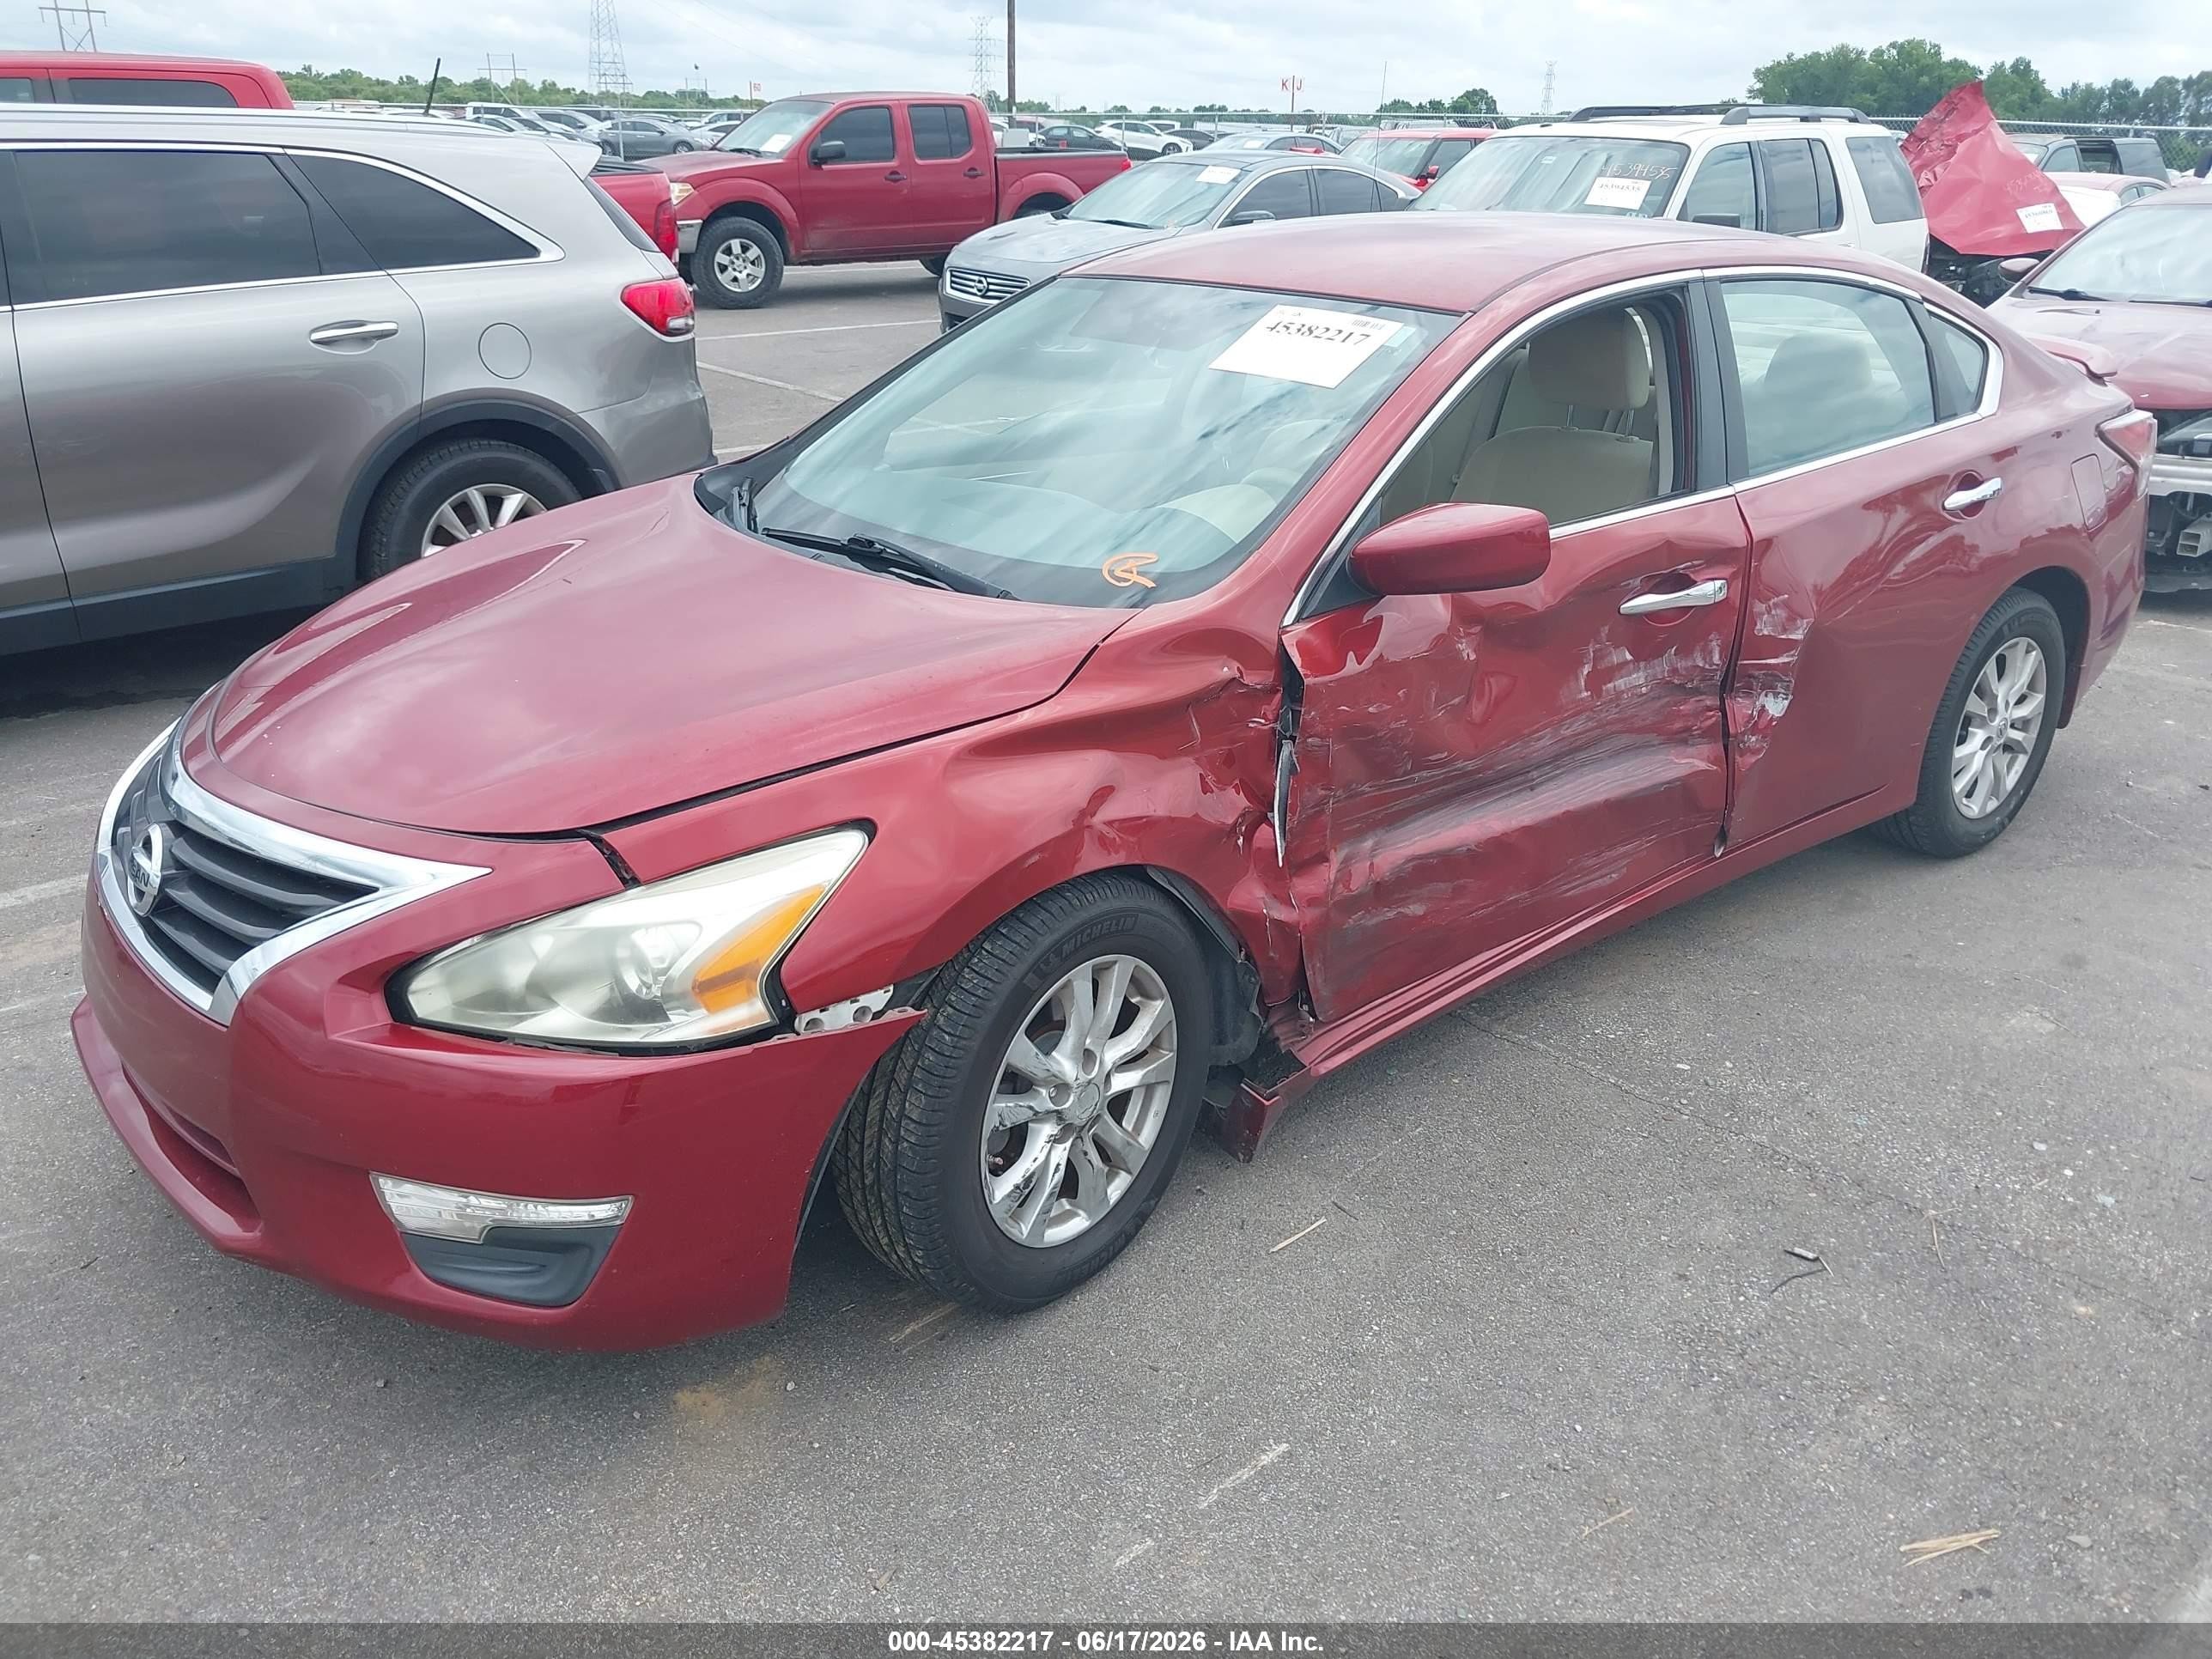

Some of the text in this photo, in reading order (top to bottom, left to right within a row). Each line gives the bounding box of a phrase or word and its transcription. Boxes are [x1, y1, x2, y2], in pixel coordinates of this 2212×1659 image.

[1281, 78, 1303, 91] K J
[1266, 321, 1371, 344] 45382217
[1063, 916, 1135, 955] MICHELIN
